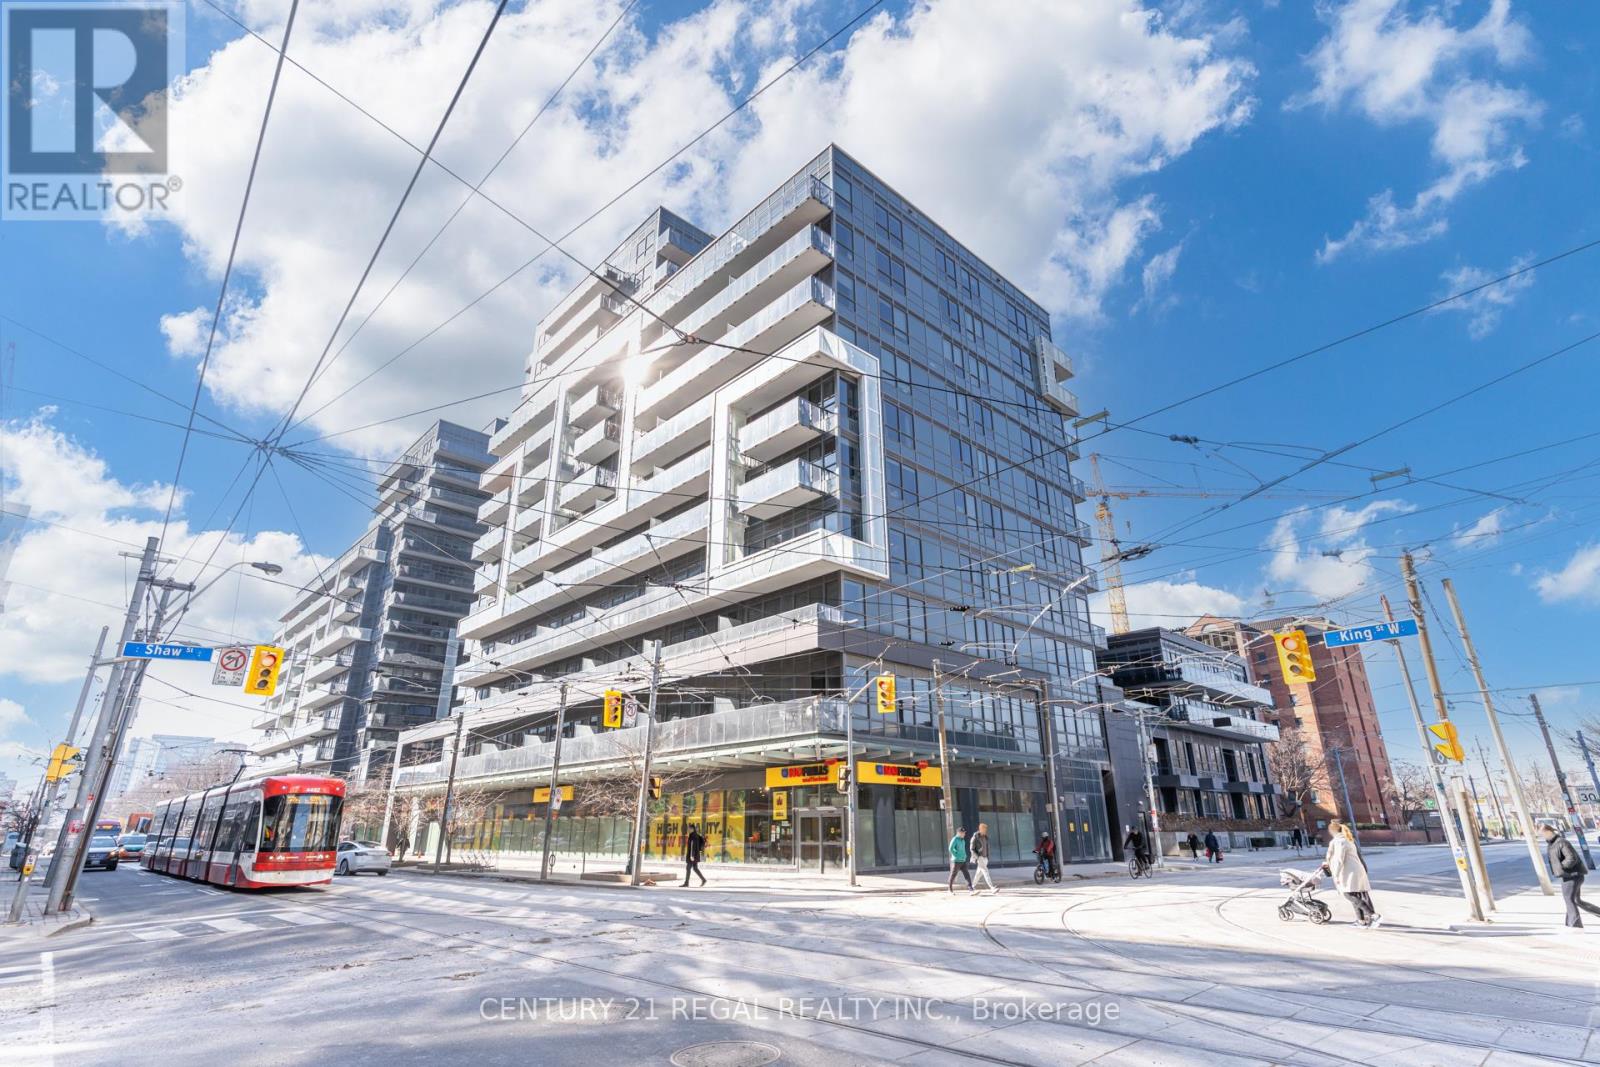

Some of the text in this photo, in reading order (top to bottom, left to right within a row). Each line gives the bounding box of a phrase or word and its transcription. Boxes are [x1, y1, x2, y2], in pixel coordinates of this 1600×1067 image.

[1340, 629, 1373, 642] King
[1387, 623, 1400, 635] W
[145, 644, 182, 657] Shaw
[1580, 792, 1597, 802] 30
